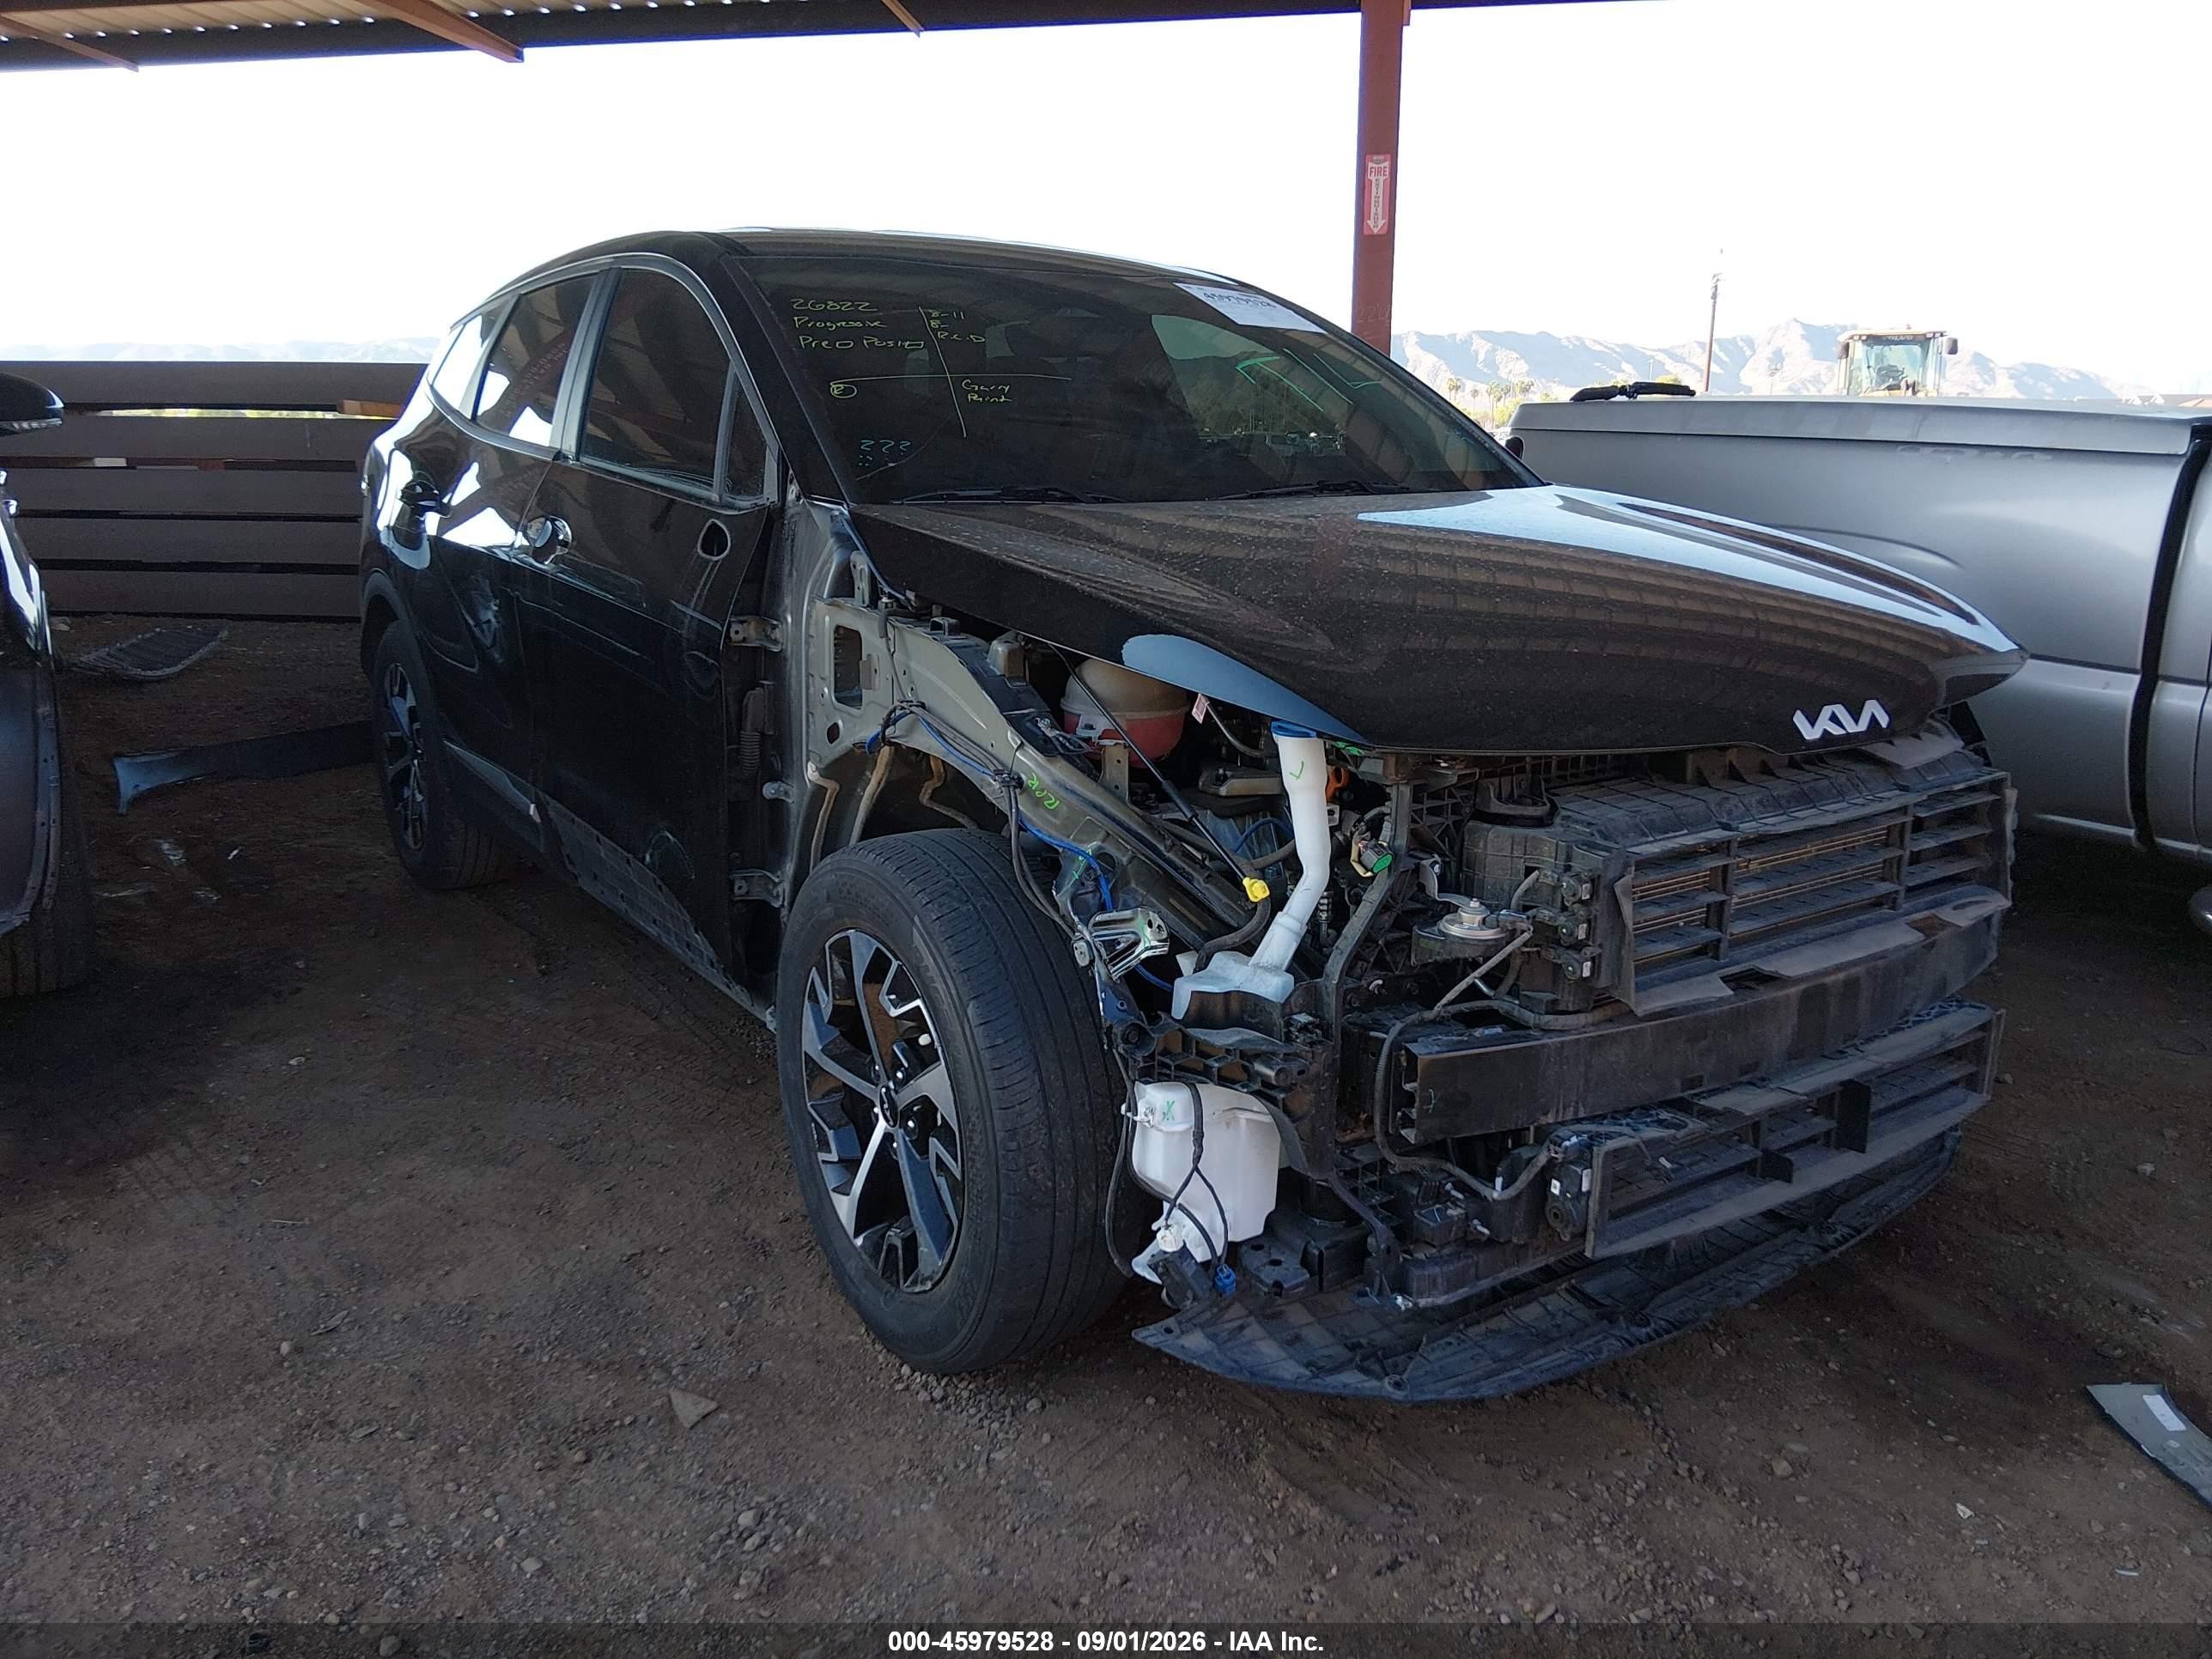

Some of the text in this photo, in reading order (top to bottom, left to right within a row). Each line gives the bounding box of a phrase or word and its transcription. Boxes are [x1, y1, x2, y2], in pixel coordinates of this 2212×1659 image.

[1370, 166, 1388, 178] FIRE
[790, 298, 878, 311] 26822
[1792, 698, 1890, 741] KIA
